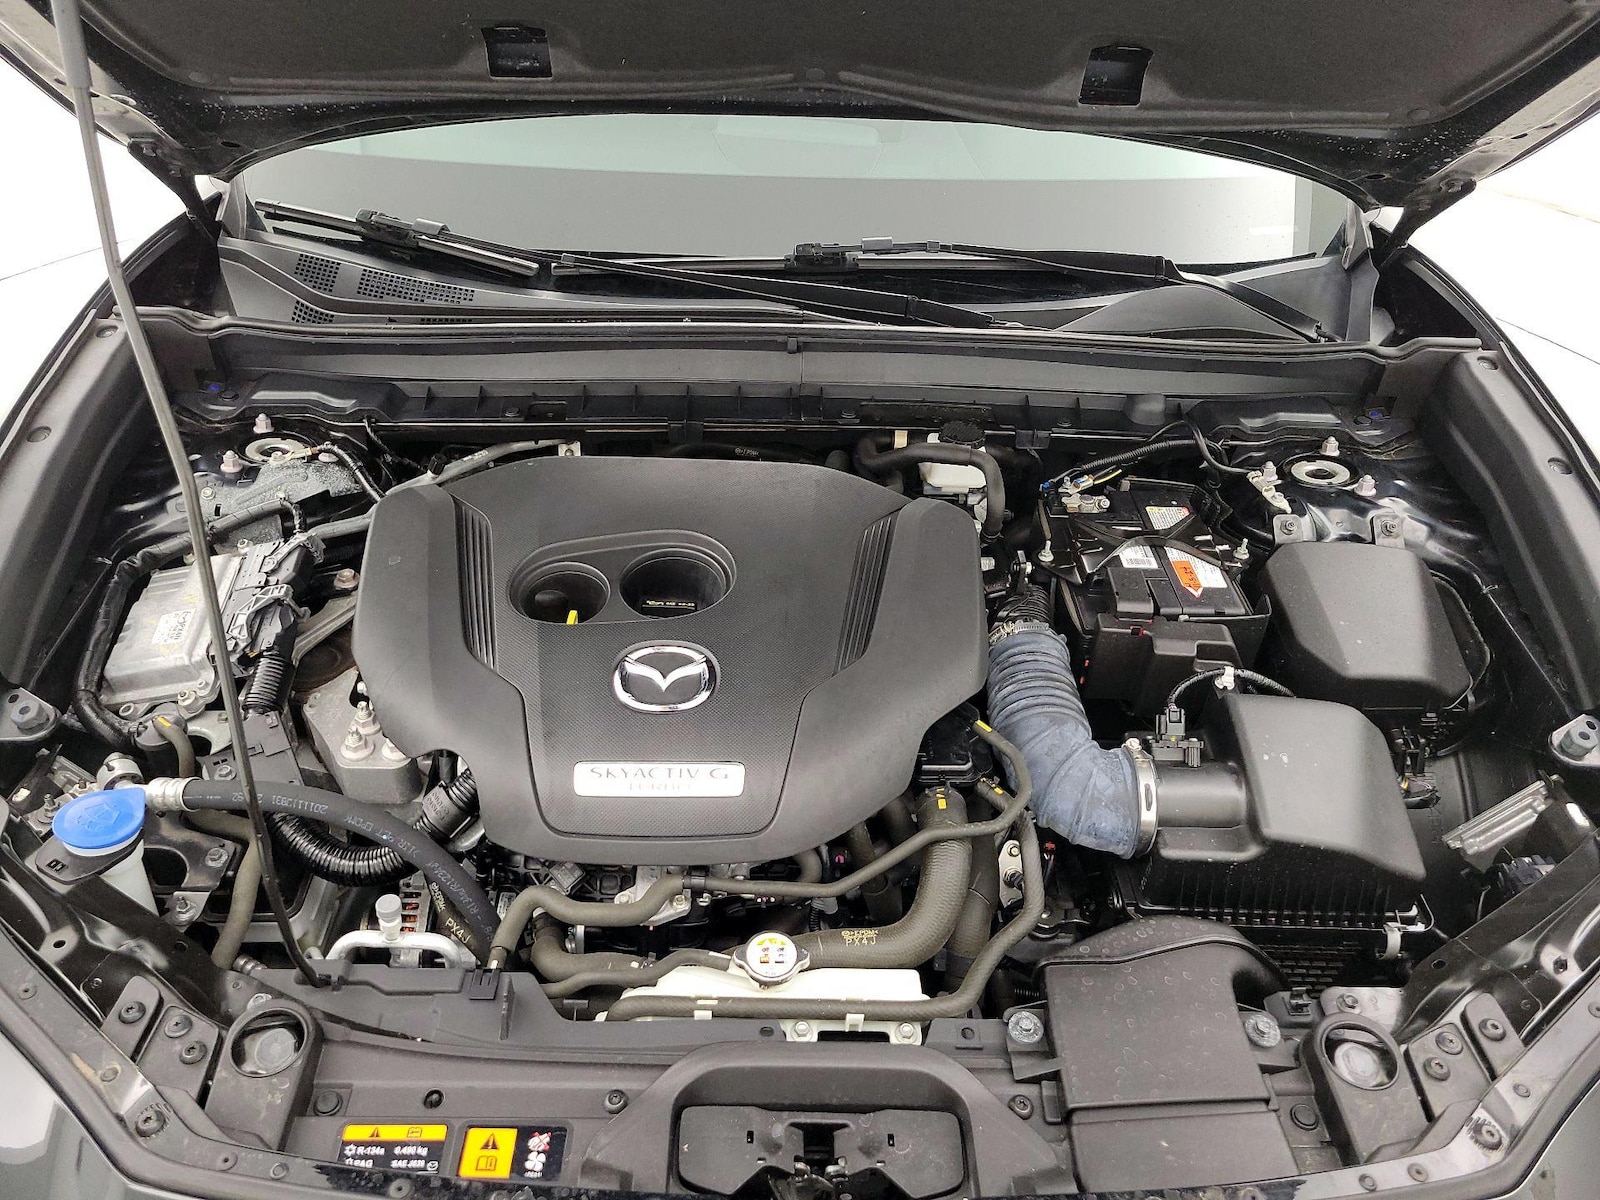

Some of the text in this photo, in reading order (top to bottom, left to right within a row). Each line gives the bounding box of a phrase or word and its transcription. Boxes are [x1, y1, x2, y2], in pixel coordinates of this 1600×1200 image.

[590, 766, 729, 779] SKYACTIV G
[445, 917, 472, 944] PX4J
[845, 936, 876, 947] PX4J
